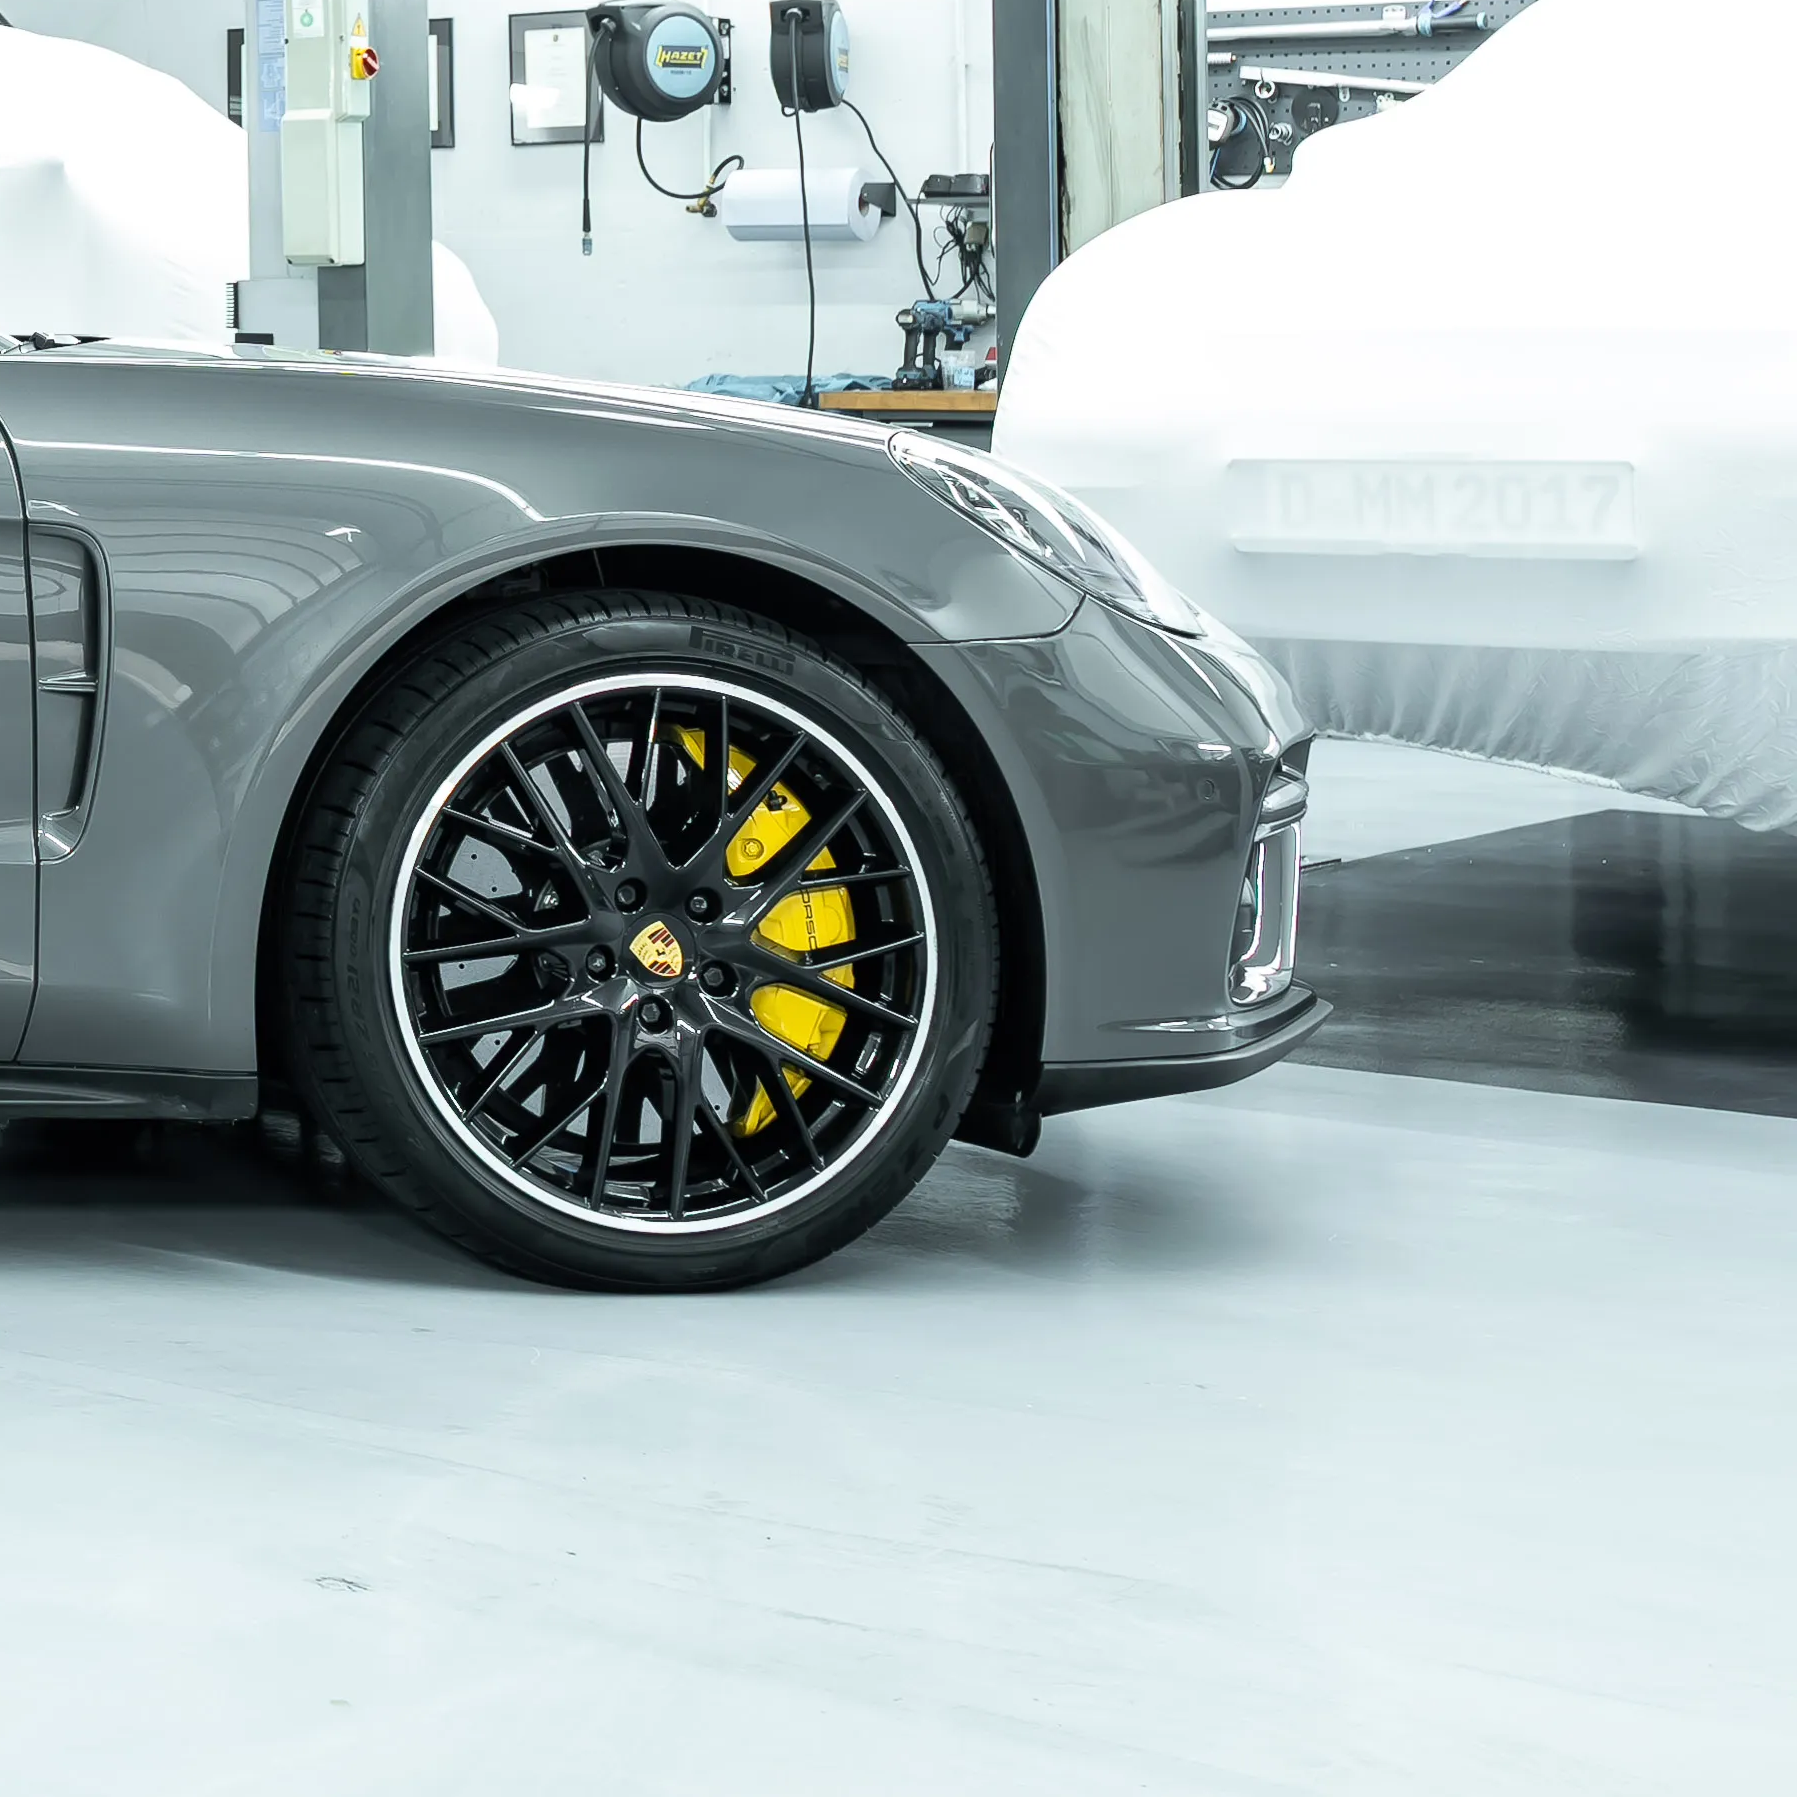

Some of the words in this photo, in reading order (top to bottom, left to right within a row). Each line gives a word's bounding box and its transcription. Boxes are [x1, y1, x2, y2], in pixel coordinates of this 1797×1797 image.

[658, 49, 704, 63] HAZET
[1451, 470, 1621, 536] 2017
[688, 625, 796, 676] PIRELLI
